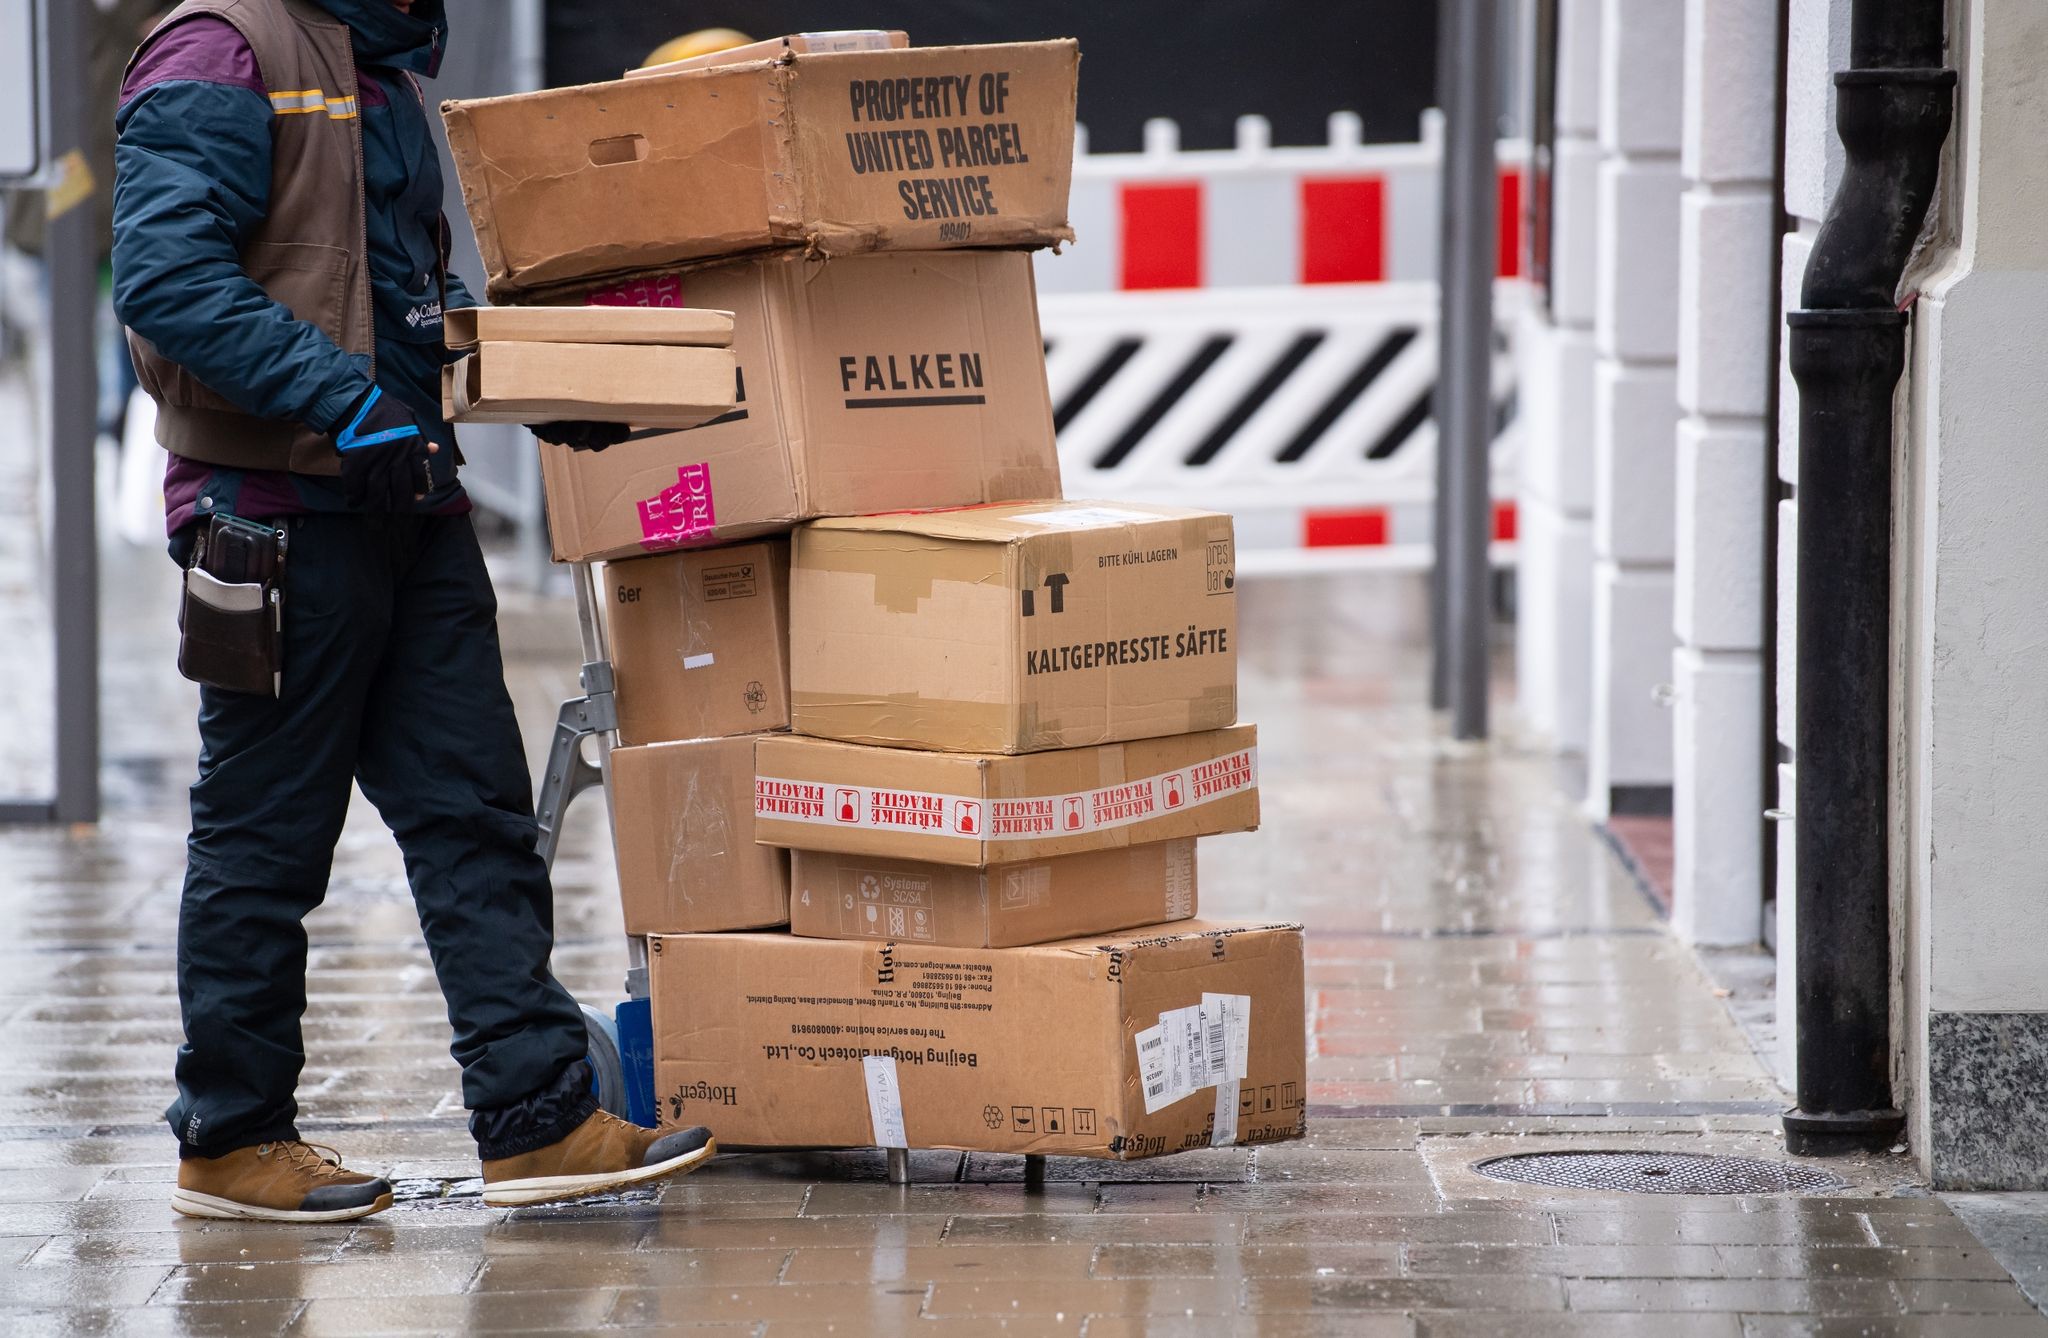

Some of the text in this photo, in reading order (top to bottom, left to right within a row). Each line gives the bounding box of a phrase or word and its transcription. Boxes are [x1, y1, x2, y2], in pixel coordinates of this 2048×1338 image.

[850, 72, 1009, 122] PROPERTY OF
[846, 123, 1028, 175] UNITED PARCEL
[898, 175, 998, 221] SERVICE
[839, 353, 983, 392] FALKEN
[1098, 548, 1178, 568] BITTE KÜHL LAGERN
[1206, 542, 1229, 566] pres
[1206, 569, 1224, 592] bar
[617, 584, 642, 604] 6er
[1027, 625, 1227, 675] KALTGEPRESSTE SÄFTE
[1191, 752, 1250, 782] FRAGILE
[756, 780, 825, 801] FRAGILE
[1093, 781, 1153, 807] FRAGILE
[871, 791, 944, 812] FRAGILE
[992, 800, 1054, 816] FRAGILE
[801, 889, 811, 907] 4
[844, 893, 854, 910] 3
[955, 973, 962, 981] 10
[977, 974, 992, 982] Fax:
[894, 990, 908, 998] P.R.
[954, 983, 967, 991] +86
[968, 983, 992, 992] Phone:
[773, 995, 797, 1005] Daxing
[797, 996, 816, 1005] Base,
[816, 997, 854, 1006] Biomedical
[877, 999, 898, 1008] Tianfu
[905, 1000, 917, 1009] No.
[845, 1025, 875, 1035] hotline
[876, 1027, 908, 1037] service
[910, 1028, 928, 1038] free
[929, 1029, 946, 1039] The
[926, 1048, 978, 1068] Beijing
[680, 1081, 737, 1106] Hotgen
